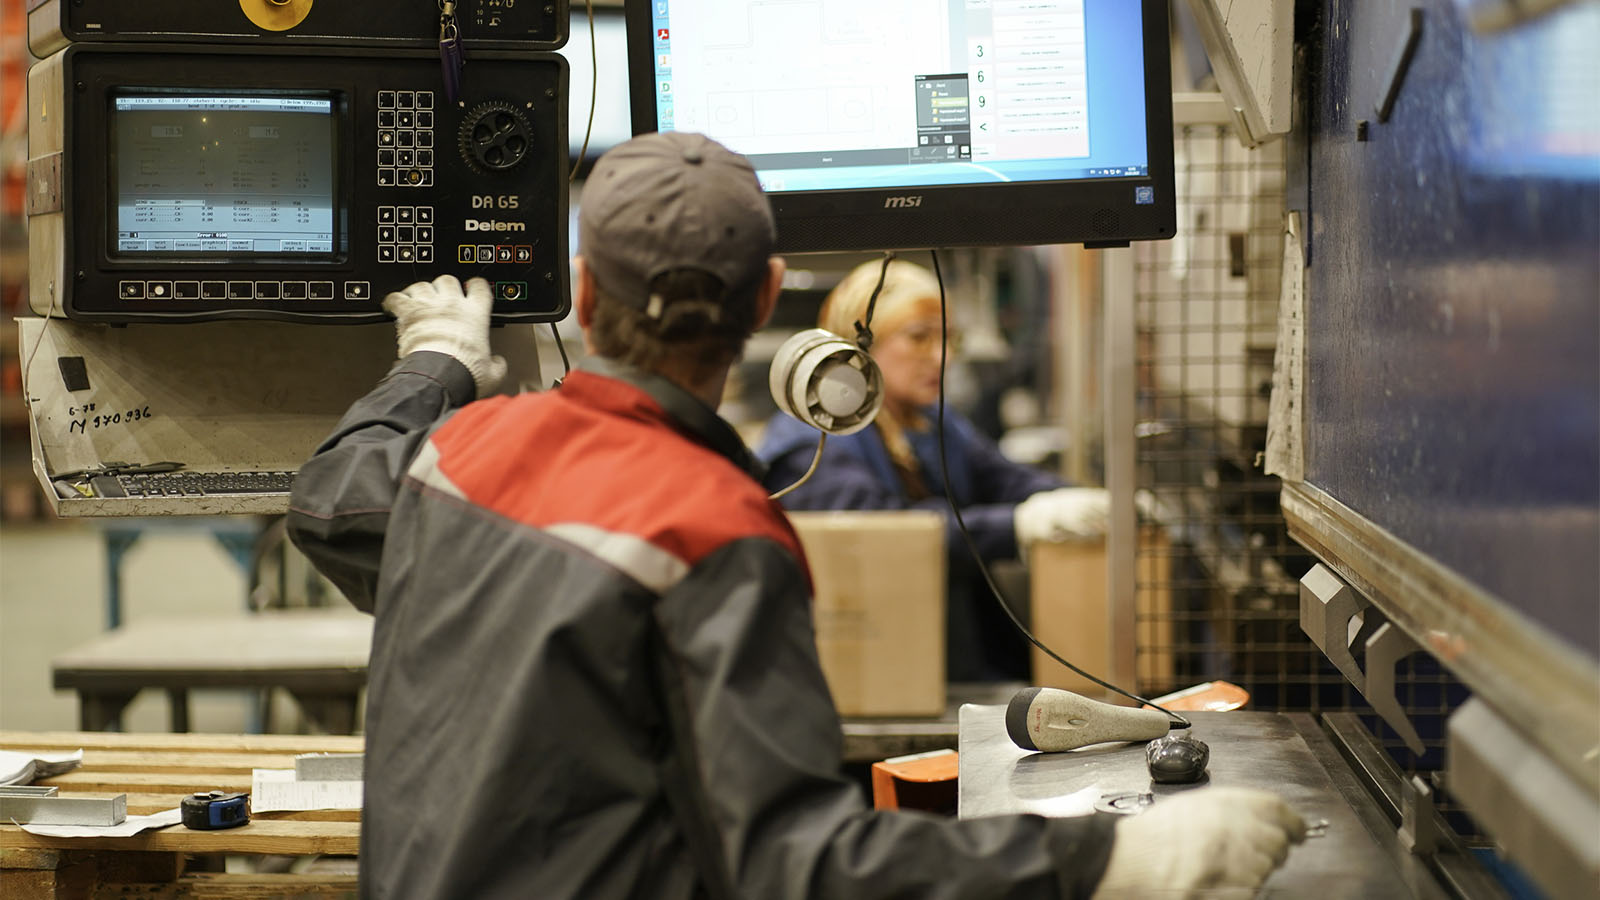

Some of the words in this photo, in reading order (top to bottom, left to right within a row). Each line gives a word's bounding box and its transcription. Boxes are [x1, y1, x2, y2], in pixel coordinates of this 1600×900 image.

[976, 44, 984, 58] 3
[977, 70, 985, 83] 6
[978, 95, 986, 108] 9
[472, 195, 494, 209] DA
[498, 195, 520, 209] 65
[884, 196, 923, 208] msi
[464, 219, 526, 232] Delem
